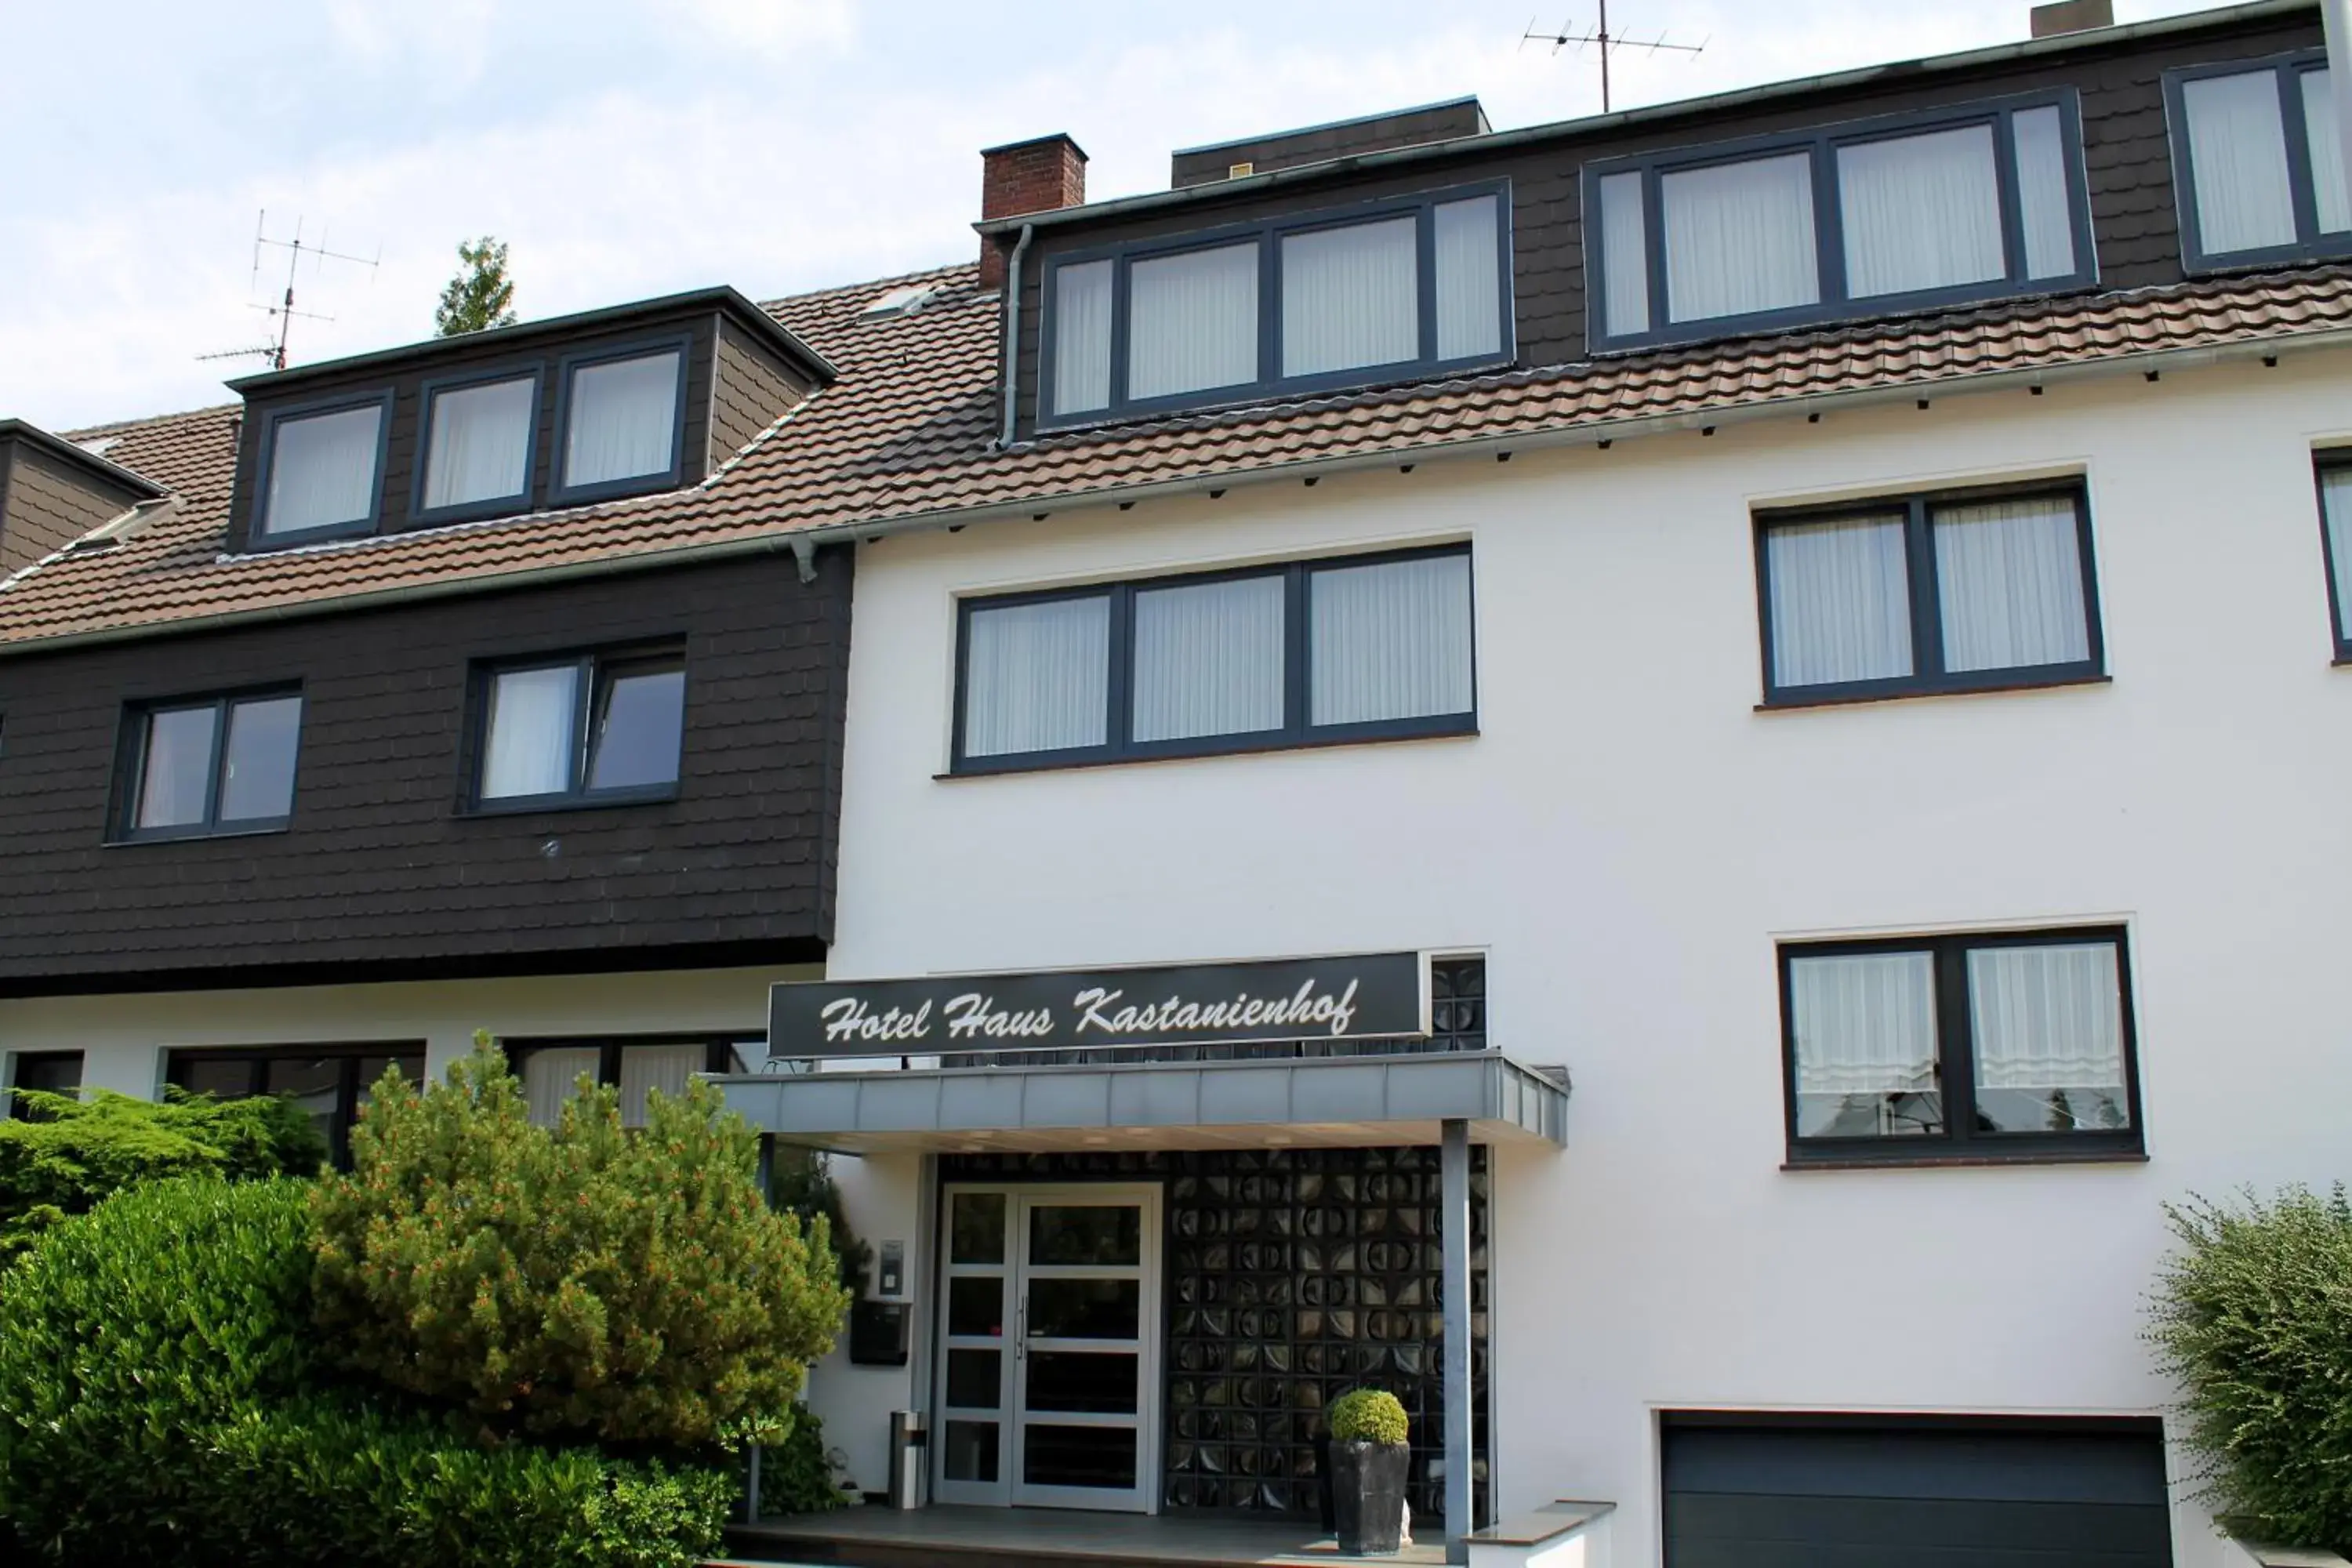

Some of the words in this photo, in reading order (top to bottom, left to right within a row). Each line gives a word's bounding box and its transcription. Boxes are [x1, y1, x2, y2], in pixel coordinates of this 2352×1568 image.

[821, 997, 931, 1041] Hotel
[943, 993, 1054, 1038] Haus
[1073, 978, 1359, 1036] Kastanienhof
